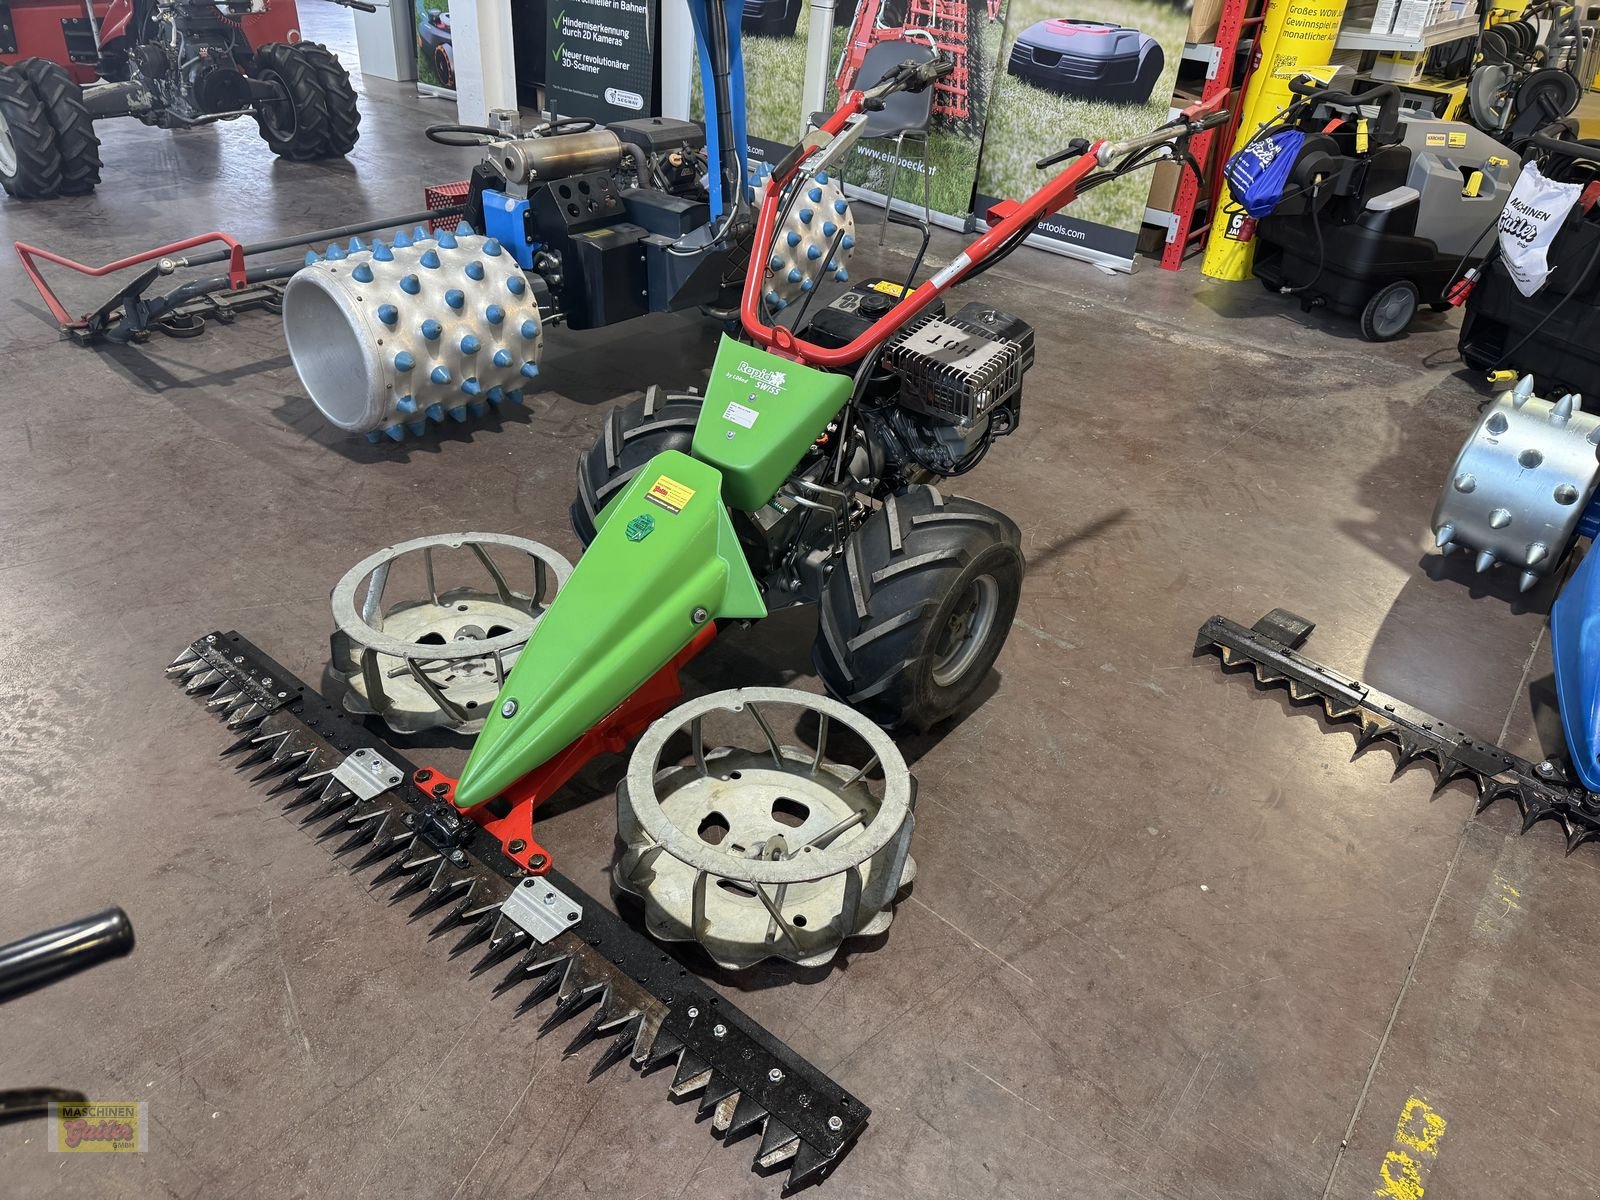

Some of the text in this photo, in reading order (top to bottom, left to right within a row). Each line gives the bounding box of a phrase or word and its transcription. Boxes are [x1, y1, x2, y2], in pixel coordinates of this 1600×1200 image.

[613, 1, 619, 9] in
[620, 1, 647, 14] Bahnen
[1290, 5, 1317, 16] Großes
[562, 16, 629, 39] Hinderniserkennung
[1286, 17, 1330, 30] Gewinnspiel
[562, 28, 623, 46] durch 2D Kameras
[1283, 30, 1327, 40] monatlicher
[562, 48, 630, 70] Neuer revolutionärer
[562, 58, 600, 74] 3D-Scanner
[1037, 221, 1085, 240] ertools.com
[927, 334, 976, 357] HOT
[737, 360, 774, 381] Rapid
[755, 381, 780, 395] SWISS
